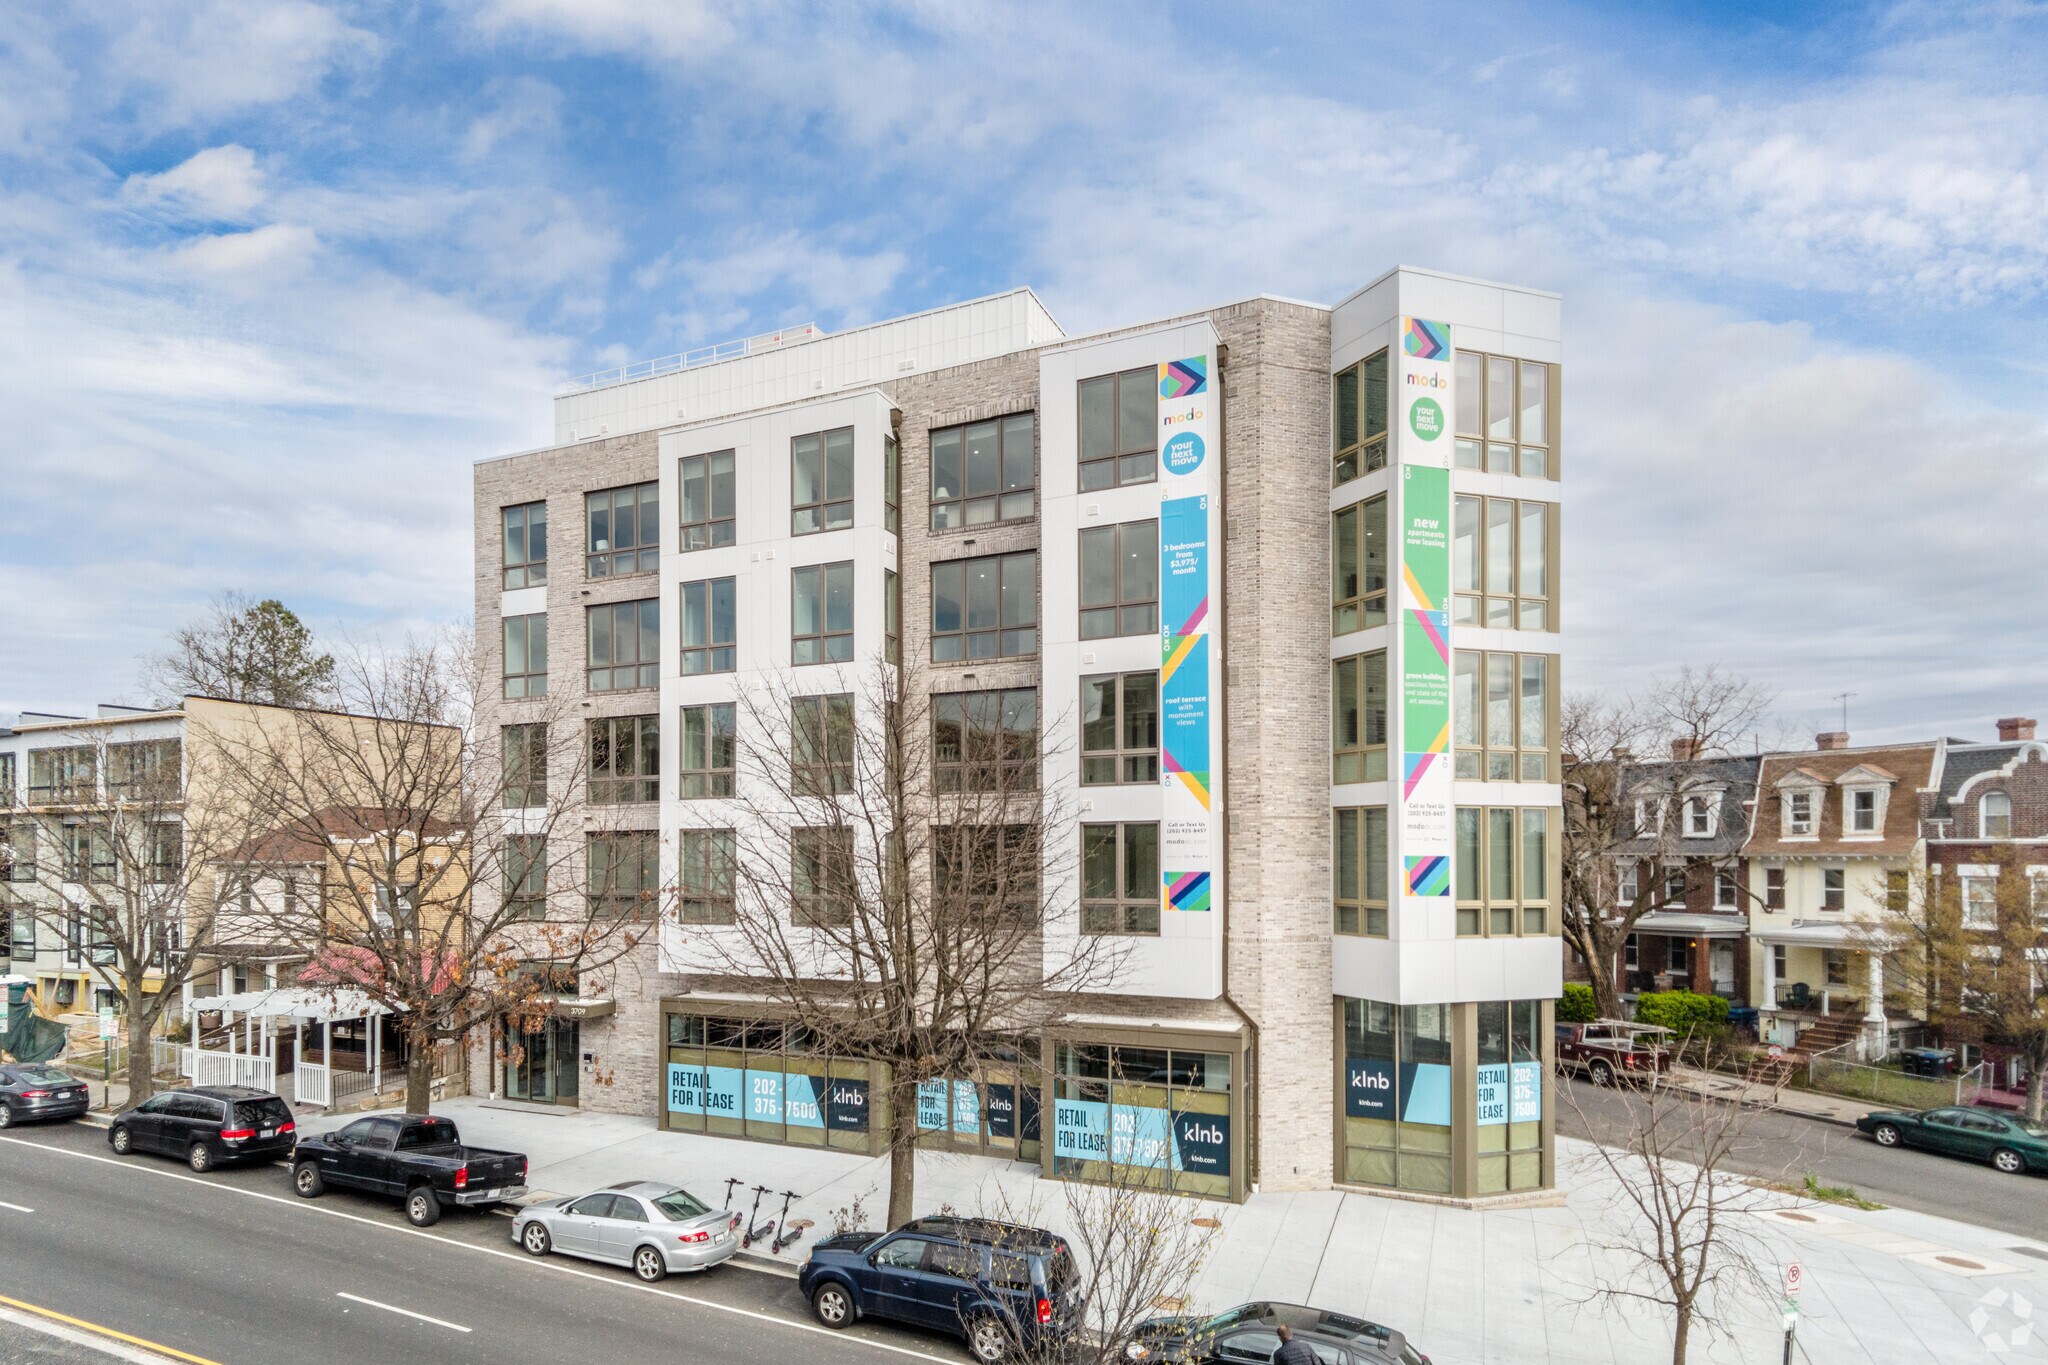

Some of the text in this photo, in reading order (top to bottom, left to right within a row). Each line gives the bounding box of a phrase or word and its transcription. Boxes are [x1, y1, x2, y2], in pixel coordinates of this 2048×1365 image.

[1407, 371, 1447, 389] modo
[1164, 407, 1203, 426] modo
[1416, 406, 1435, 416] your
[1416, 415, 1435, 424] next
[1416, 423, 1438, 432] move
[1171, 440, 1194, 452] your
[1171, 449, 1193, 459] next
[1171, 455, 1198, 467] move
[1413, 518, 1439, 529] new
[1407, 529, 1445, 539] apartments
[1170, 541, 1205, 551] bedrooms
[1175, 551, 1193, 559] from
[1173, 566, 1196, 575] month
[1181, 695, 1206, 703] terrace
[672, 1071, 712, 1089] RETAIL
[1352, 1070, 1390, 1090] klnb
[1478, 1070, 1506, 1085] RETAIL
[672, 1089, 734, 1110] FOR LEASE
[833, 1087, 864, 1106] klnb
[1478, 1088, 1495, 1102] FOR
[921, 1096, 936, 1109] FOR
[989, 1098, 1012, 1111] klnb
[1358, 1099, 1384, 1108] klnb.com
[1514, 1101, 1537, 1117] 7500
[921, 1111, 943, 1125] LEASE
[1058, 1108, 1088, 1128] RETAIL
[1478, 1104, 1504, 1119] LEASE
[1184, 1122, 1224, 1145] klnb
[1058, 1131, 1106, 1152] FOR LEASE
[1191, 1155, 1217, 1165] klnb.com
